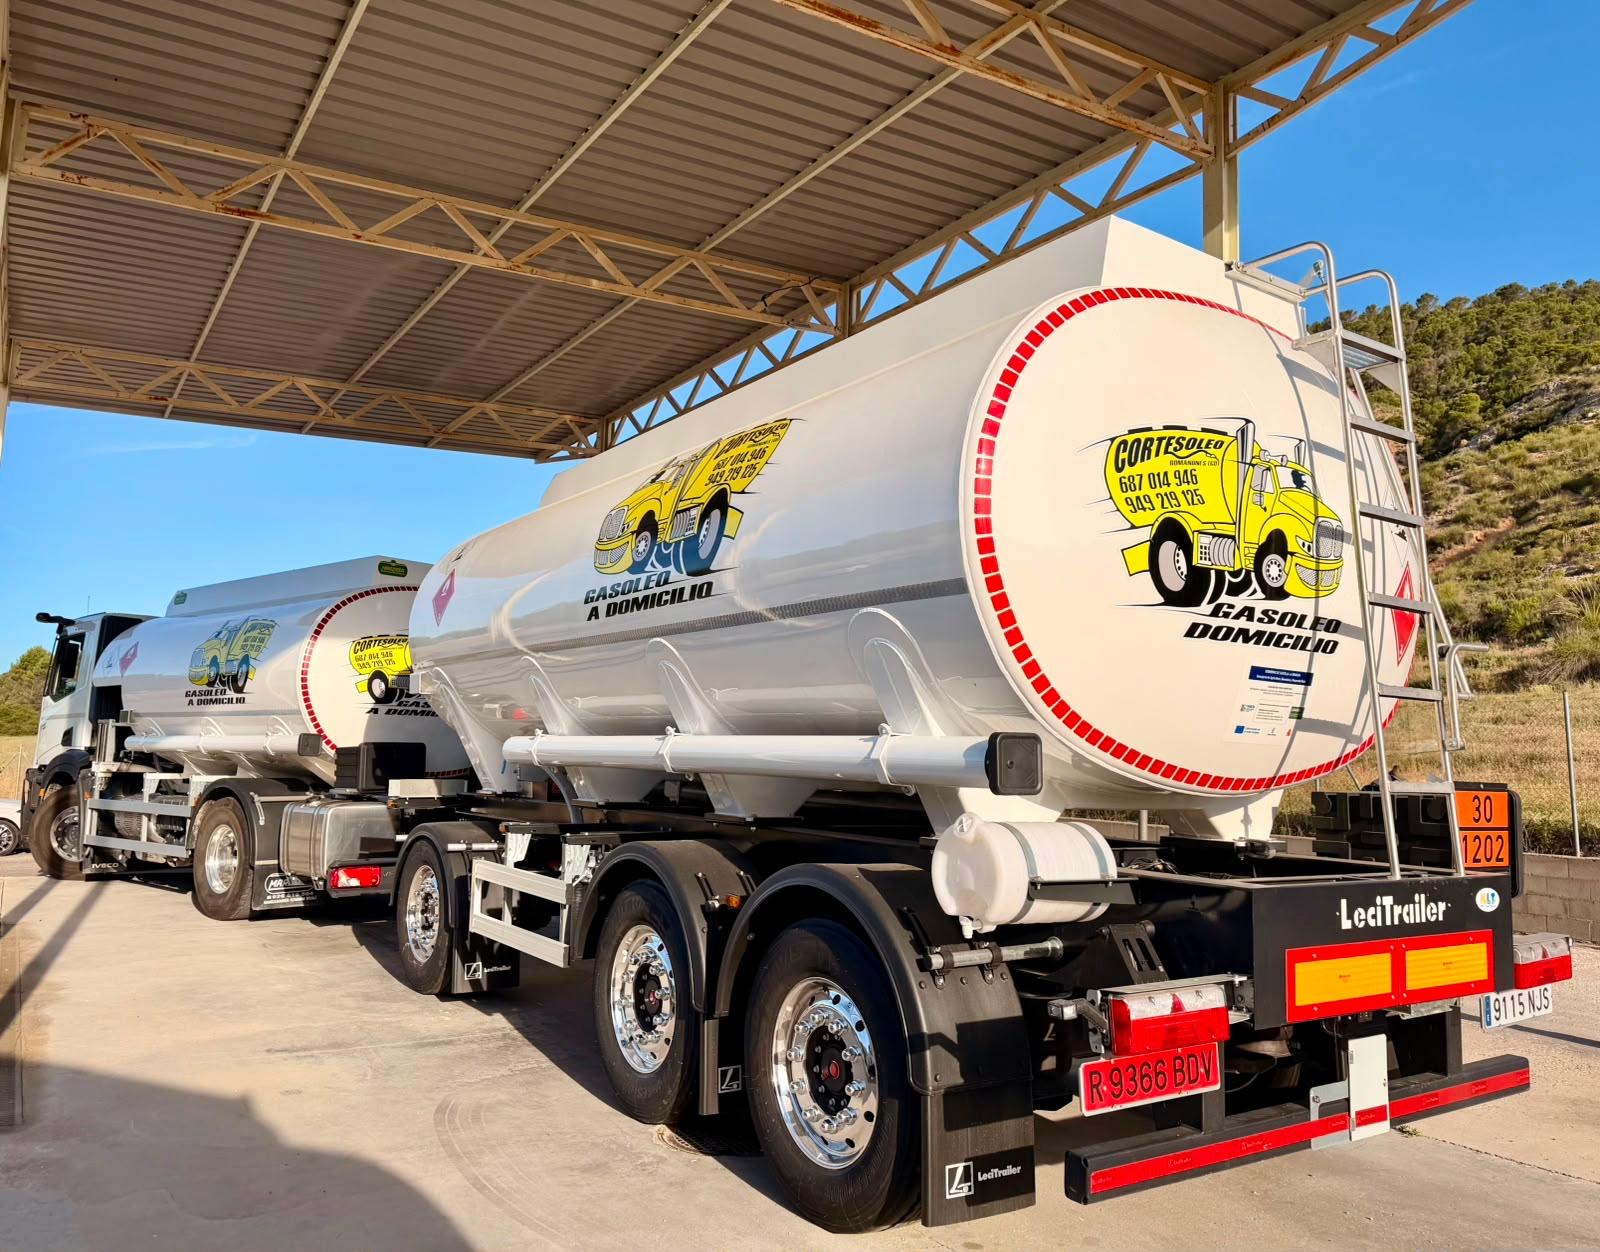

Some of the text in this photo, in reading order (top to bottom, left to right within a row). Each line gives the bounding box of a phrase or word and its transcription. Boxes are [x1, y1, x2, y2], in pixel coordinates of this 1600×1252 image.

[1114, 436, 1225, 473] CORTESOLEO
[1119, 468, 1198, 493] 687 014 946
[1125, 489, 1206, 514] 949 219 125
[584, 570, 672, 605] GASOLEO
[586, 581, 714, 621] A DOMICILIO
[1208, 602, 1342, 634] GASOLEO
[1183, 622, 1339, 655] DOMICILIO
[185, 689, 227, 698] GASOLEO
[196, 696, 246, 706] DOMICILIO
[1472, 795, 1493, 824] 30
[1463, 834, 1505, 864] 1202
[1340, 892, 1447, 930] LeciTrailer
[1494, 987, 1550, 1021] 9115 NJS
[1089, 1050, 1212, 1104] R 9366 BDV
[977, 1164, 1022, 1182] LeciTrailer
